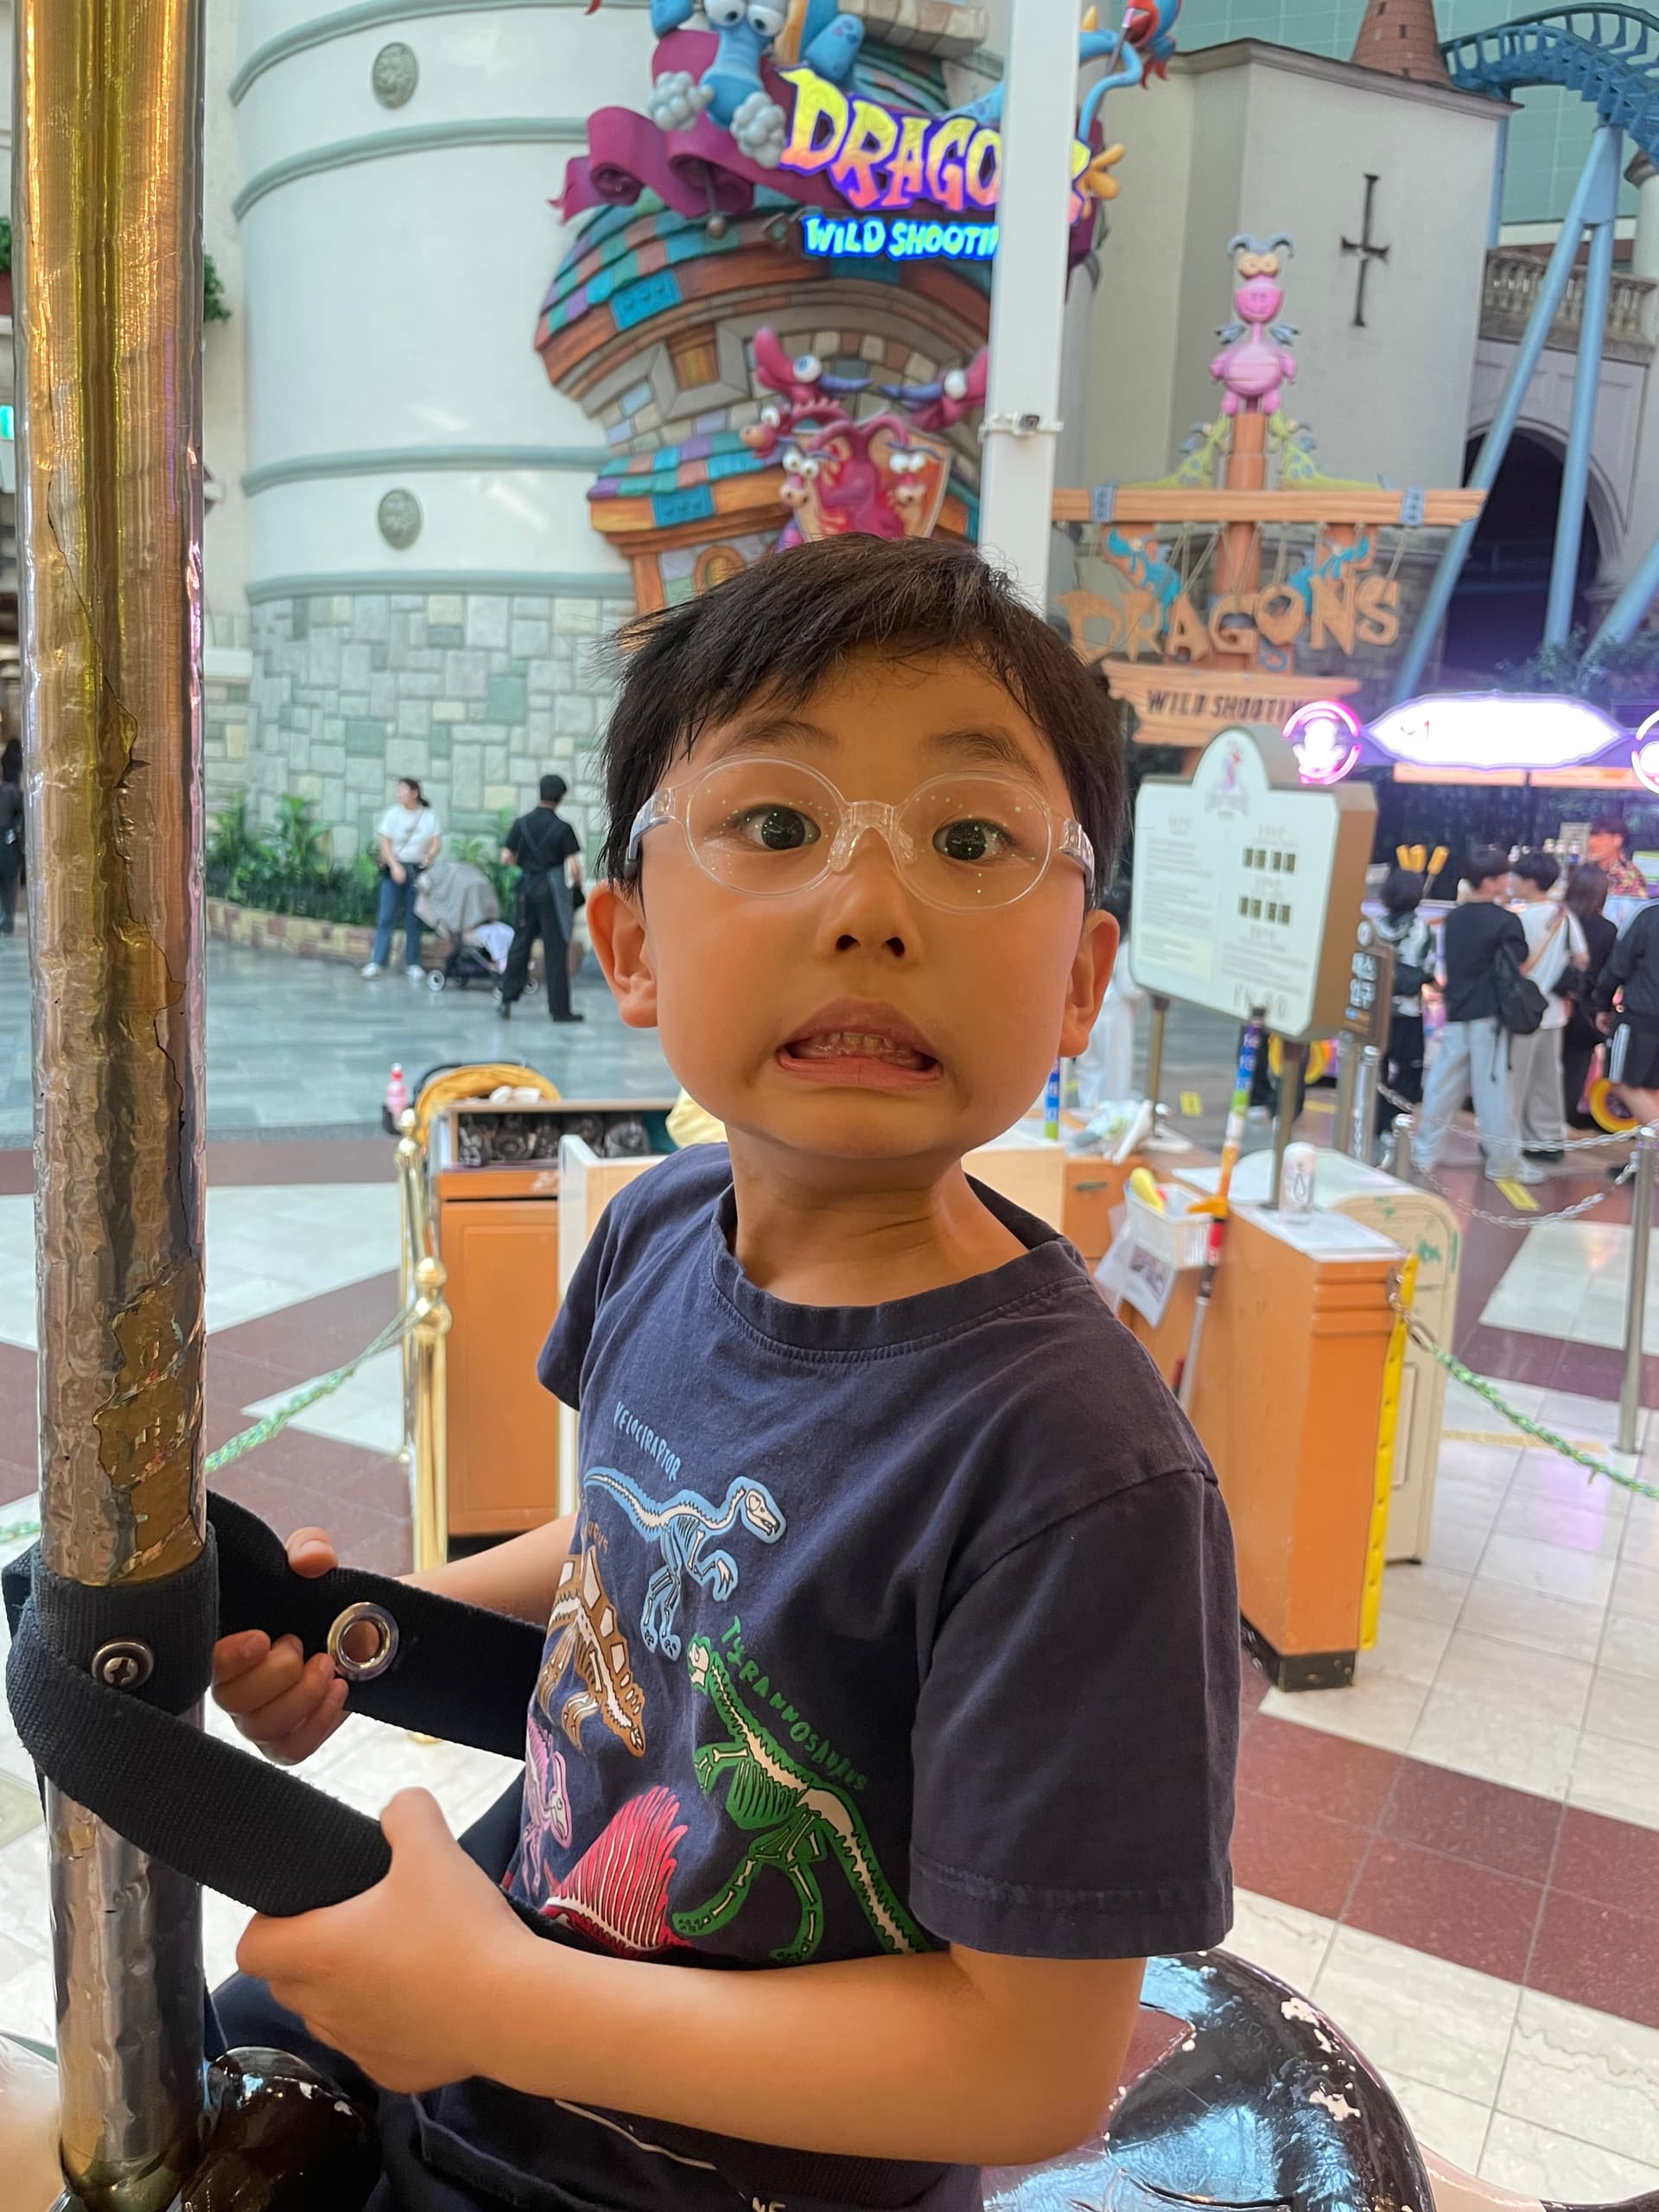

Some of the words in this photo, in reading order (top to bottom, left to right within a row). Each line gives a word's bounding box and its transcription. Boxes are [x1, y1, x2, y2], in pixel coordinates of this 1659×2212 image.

[779, 69, 1090, 223] DRAGO
[805, 218, 885, 256] WILD
[1054, 574, 1401, 664] DRAGONS
[1147, 690, 1205, 717] WILD
[613, 1401, 682, 1483] VELOCIRAPTOR
[721, 1615, 868, 1790] TYRANNOSAURUS
